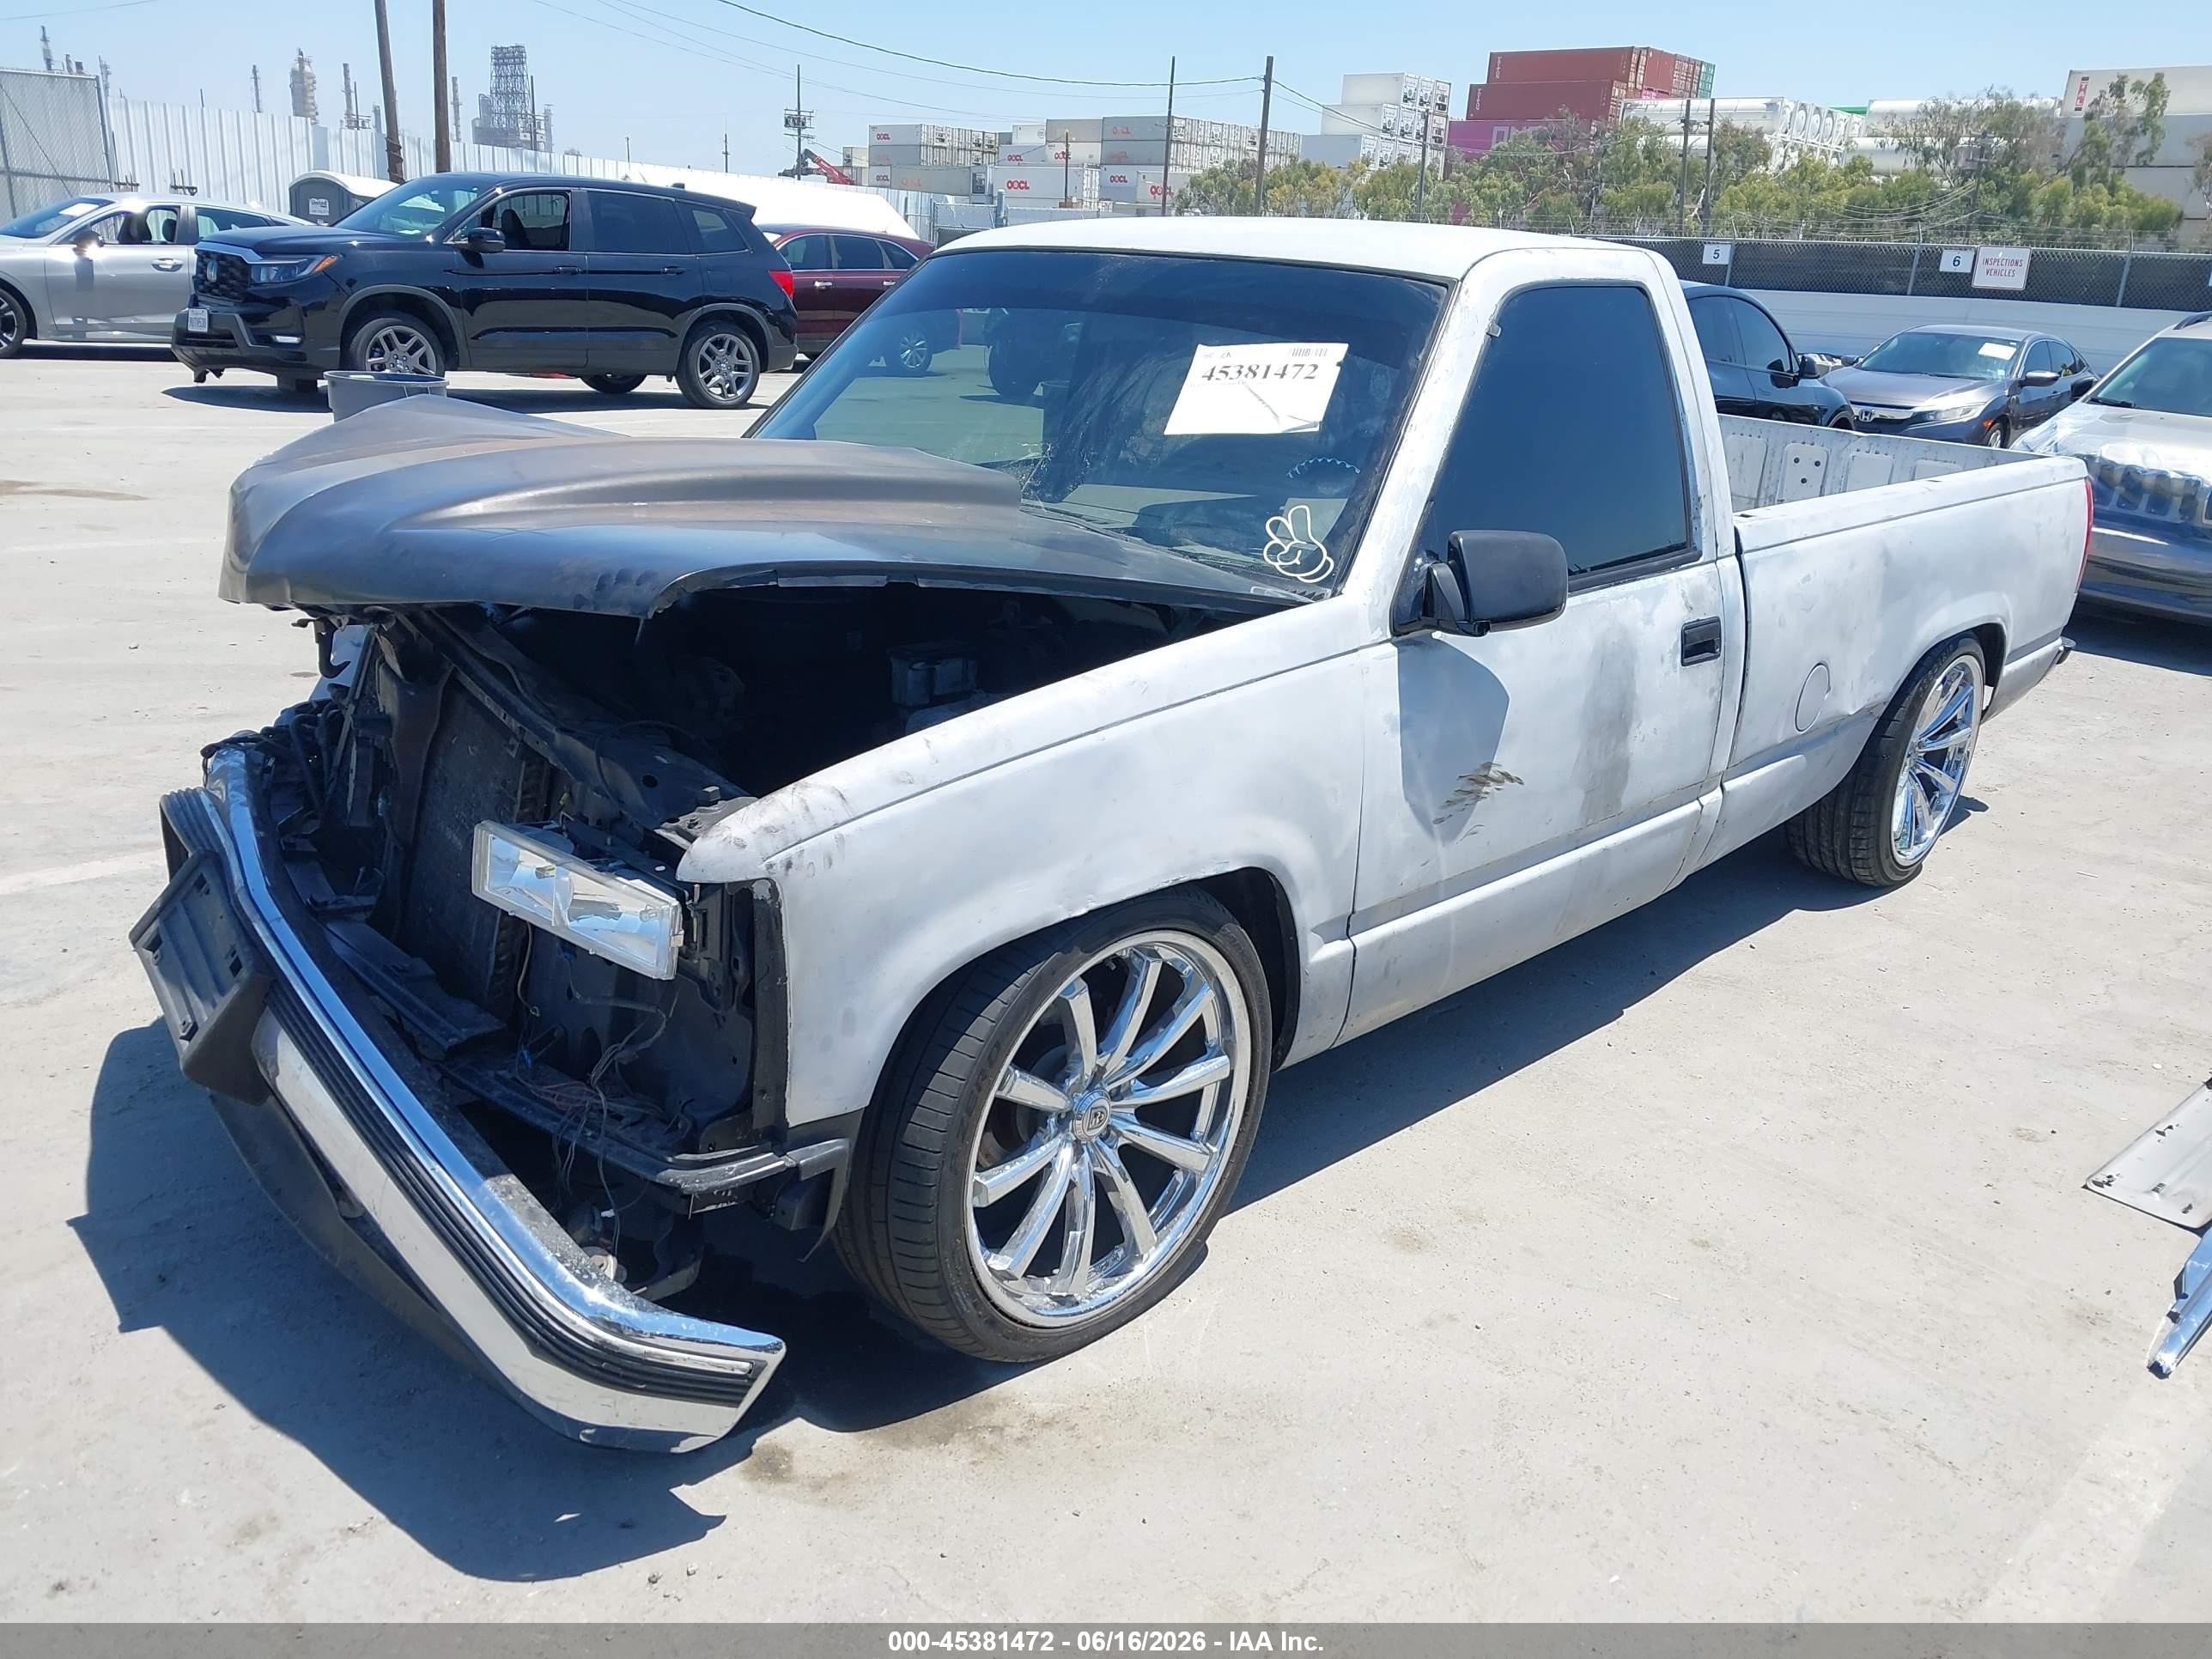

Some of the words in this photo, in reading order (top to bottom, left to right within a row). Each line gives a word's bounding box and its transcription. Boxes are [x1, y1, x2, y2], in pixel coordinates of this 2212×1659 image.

[1109, 174, 1127, 183] OOCL
[1006, 179, 1030, 190] OOCL
[1150, 185, 1175, 197] OOL
[1712, 249, 1720, 259] 5
[1952, 256, 1961, 267] 6
[1982, 258, 2024, 268] INSPECTIONS
[1985, 268, 2016, 277] VEHICLES
[1201, 363, 1319, 381] 45381472
